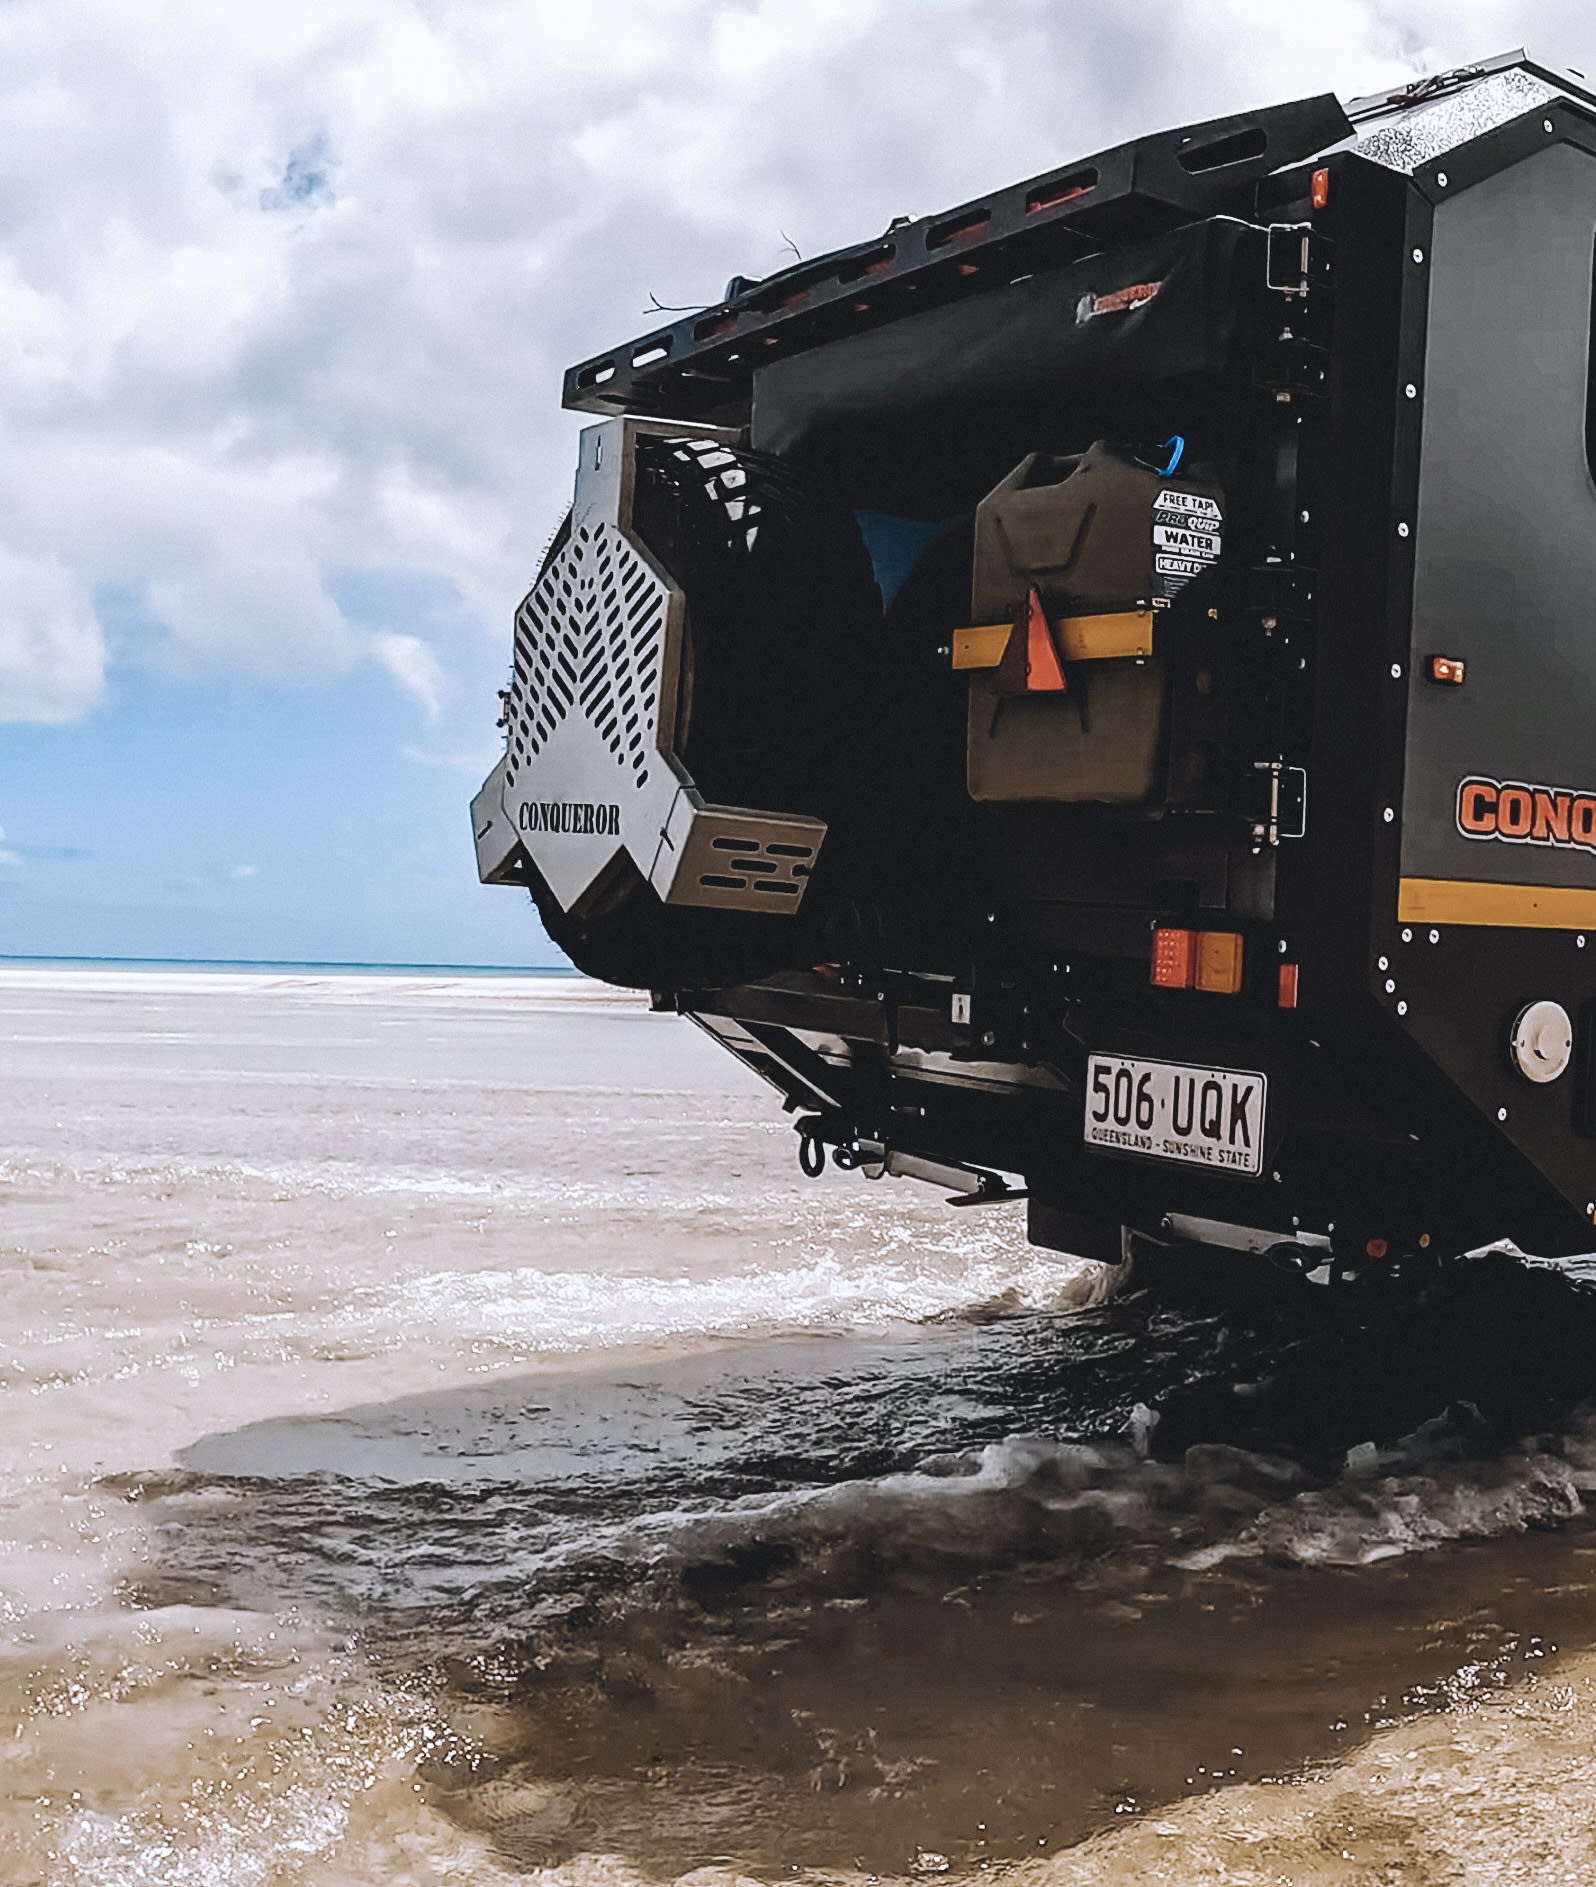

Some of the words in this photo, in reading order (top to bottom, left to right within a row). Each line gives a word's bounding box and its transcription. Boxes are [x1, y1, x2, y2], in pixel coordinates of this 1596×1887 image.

[1163, 493, 1188, 508] FREE
[1164, 529, 1213, 551] WATER
[1159, 558, 1193, 573] HEAVY
[519, 802, 620, 835] CONQUEROR
[1091, 1127, 1153, 1151] QUEENSLAND
[1162, 1139, 1213, 1161] SUNSHINE
[1218, 1150, 1250, 1168] STATE
